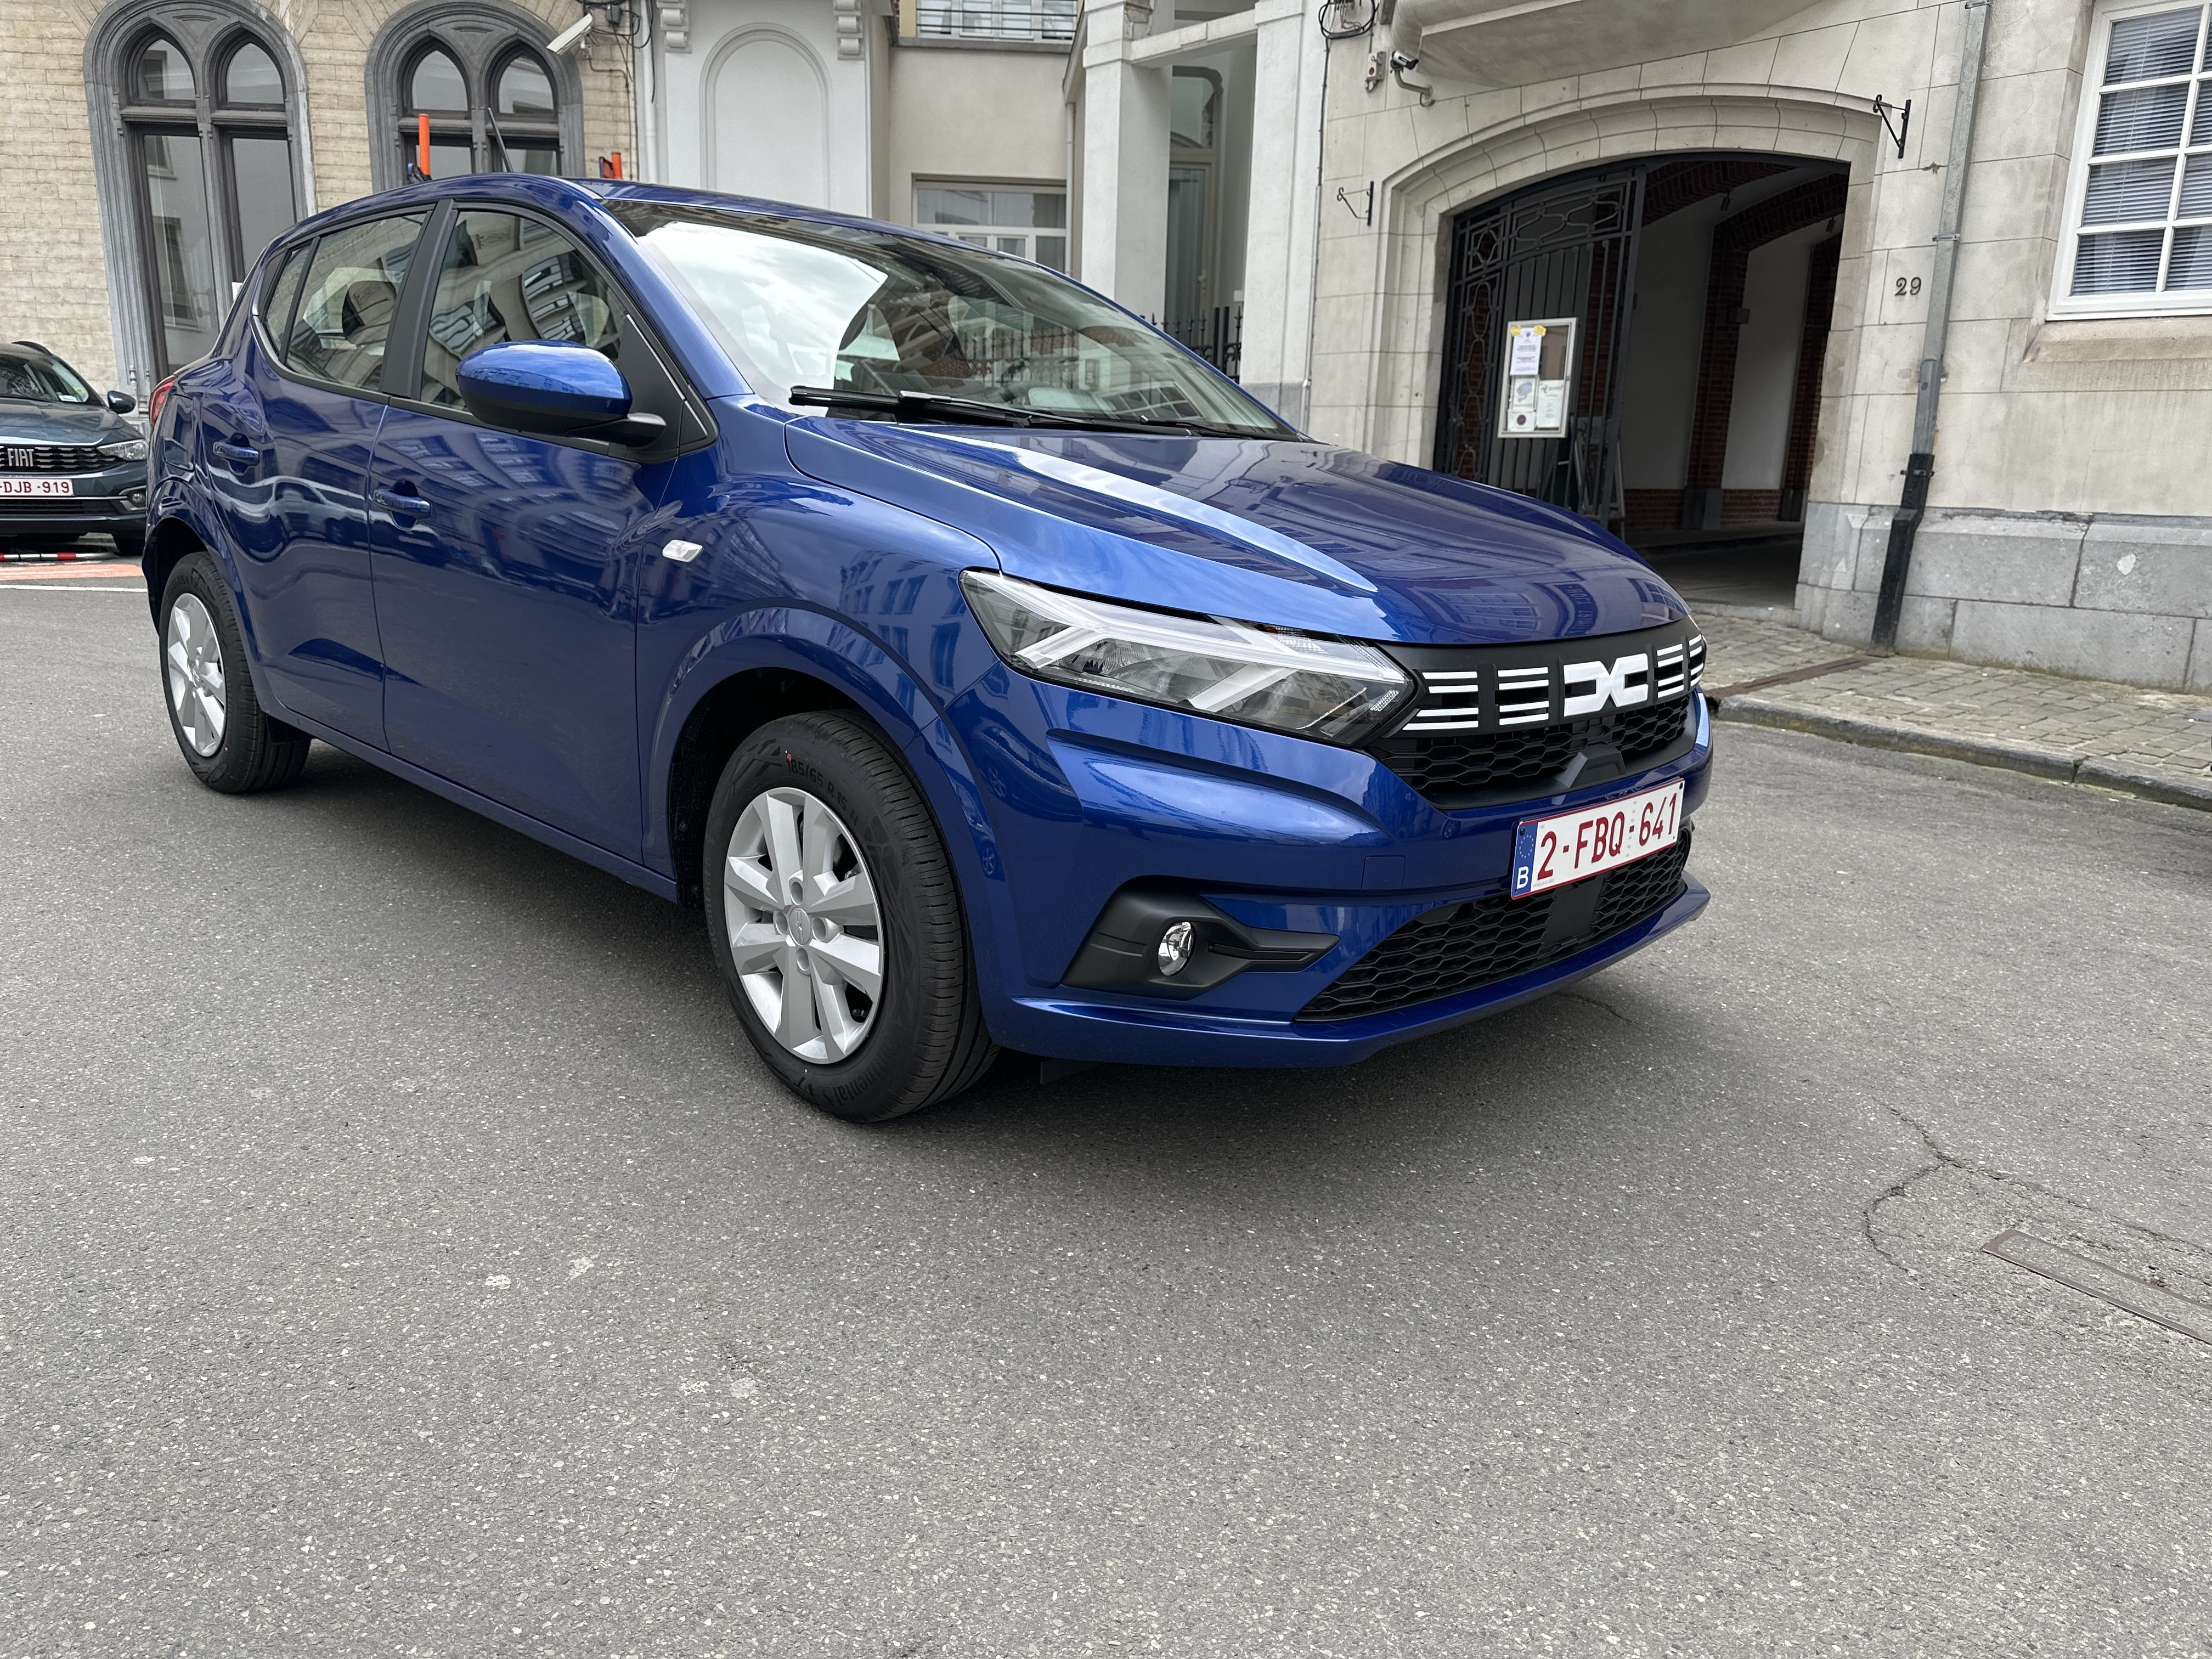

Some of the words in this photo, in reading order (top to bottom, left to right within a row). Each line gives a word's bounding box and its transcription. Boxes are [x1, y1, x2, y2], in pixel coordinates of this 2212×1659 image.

[1894, 276, 1922, 296] 29
[7, 448, 35, 467] FIAT
[786, 757, 824, 788] 185/65
[827, 780, 835, 799] R
[837, 791, 848, 811] 15
[1537, 792, 1678, 881] 2-FBQ-641
[1516, 866, 1529, 890] B
